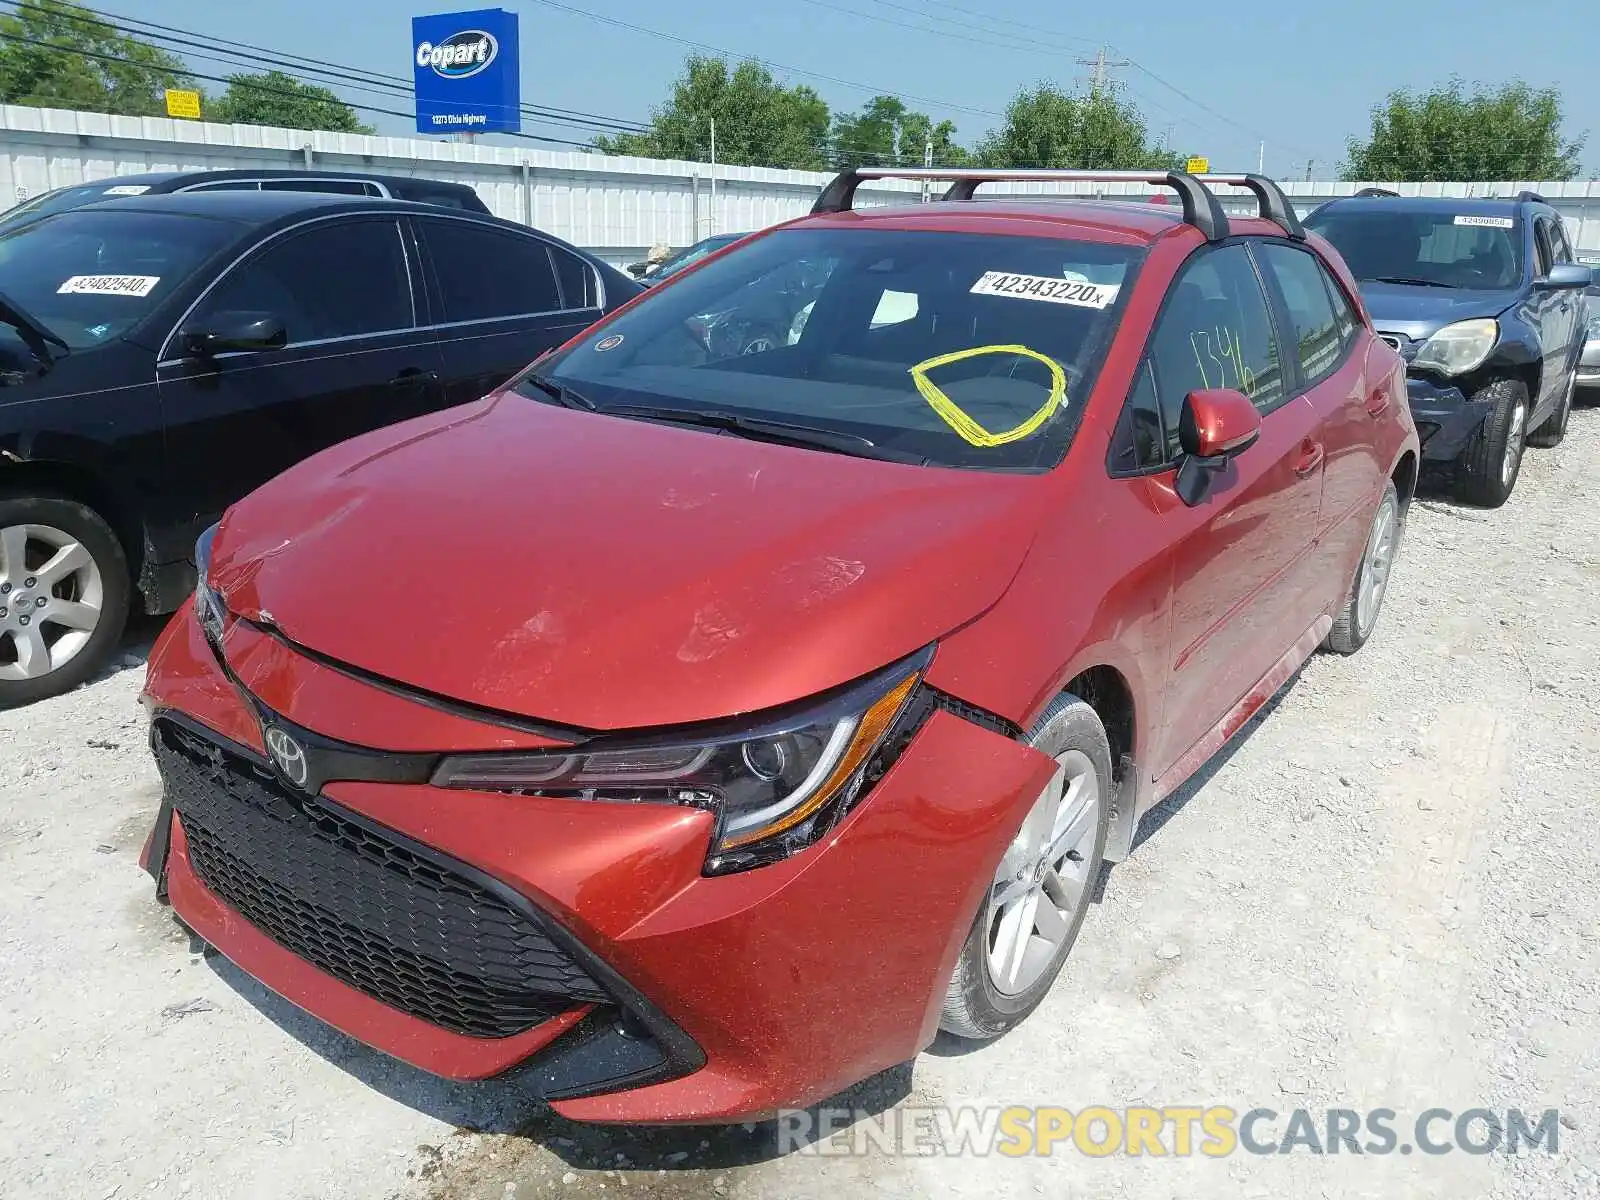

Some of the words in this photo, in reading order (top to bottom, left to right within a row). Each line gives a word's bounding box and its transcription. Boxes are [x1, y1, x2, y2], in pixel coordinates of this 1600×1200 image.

[416, 36, 488, 70] Copart
[463, 113, 487, 126] Highway
[1189, 325, 1256, 399] 1346
